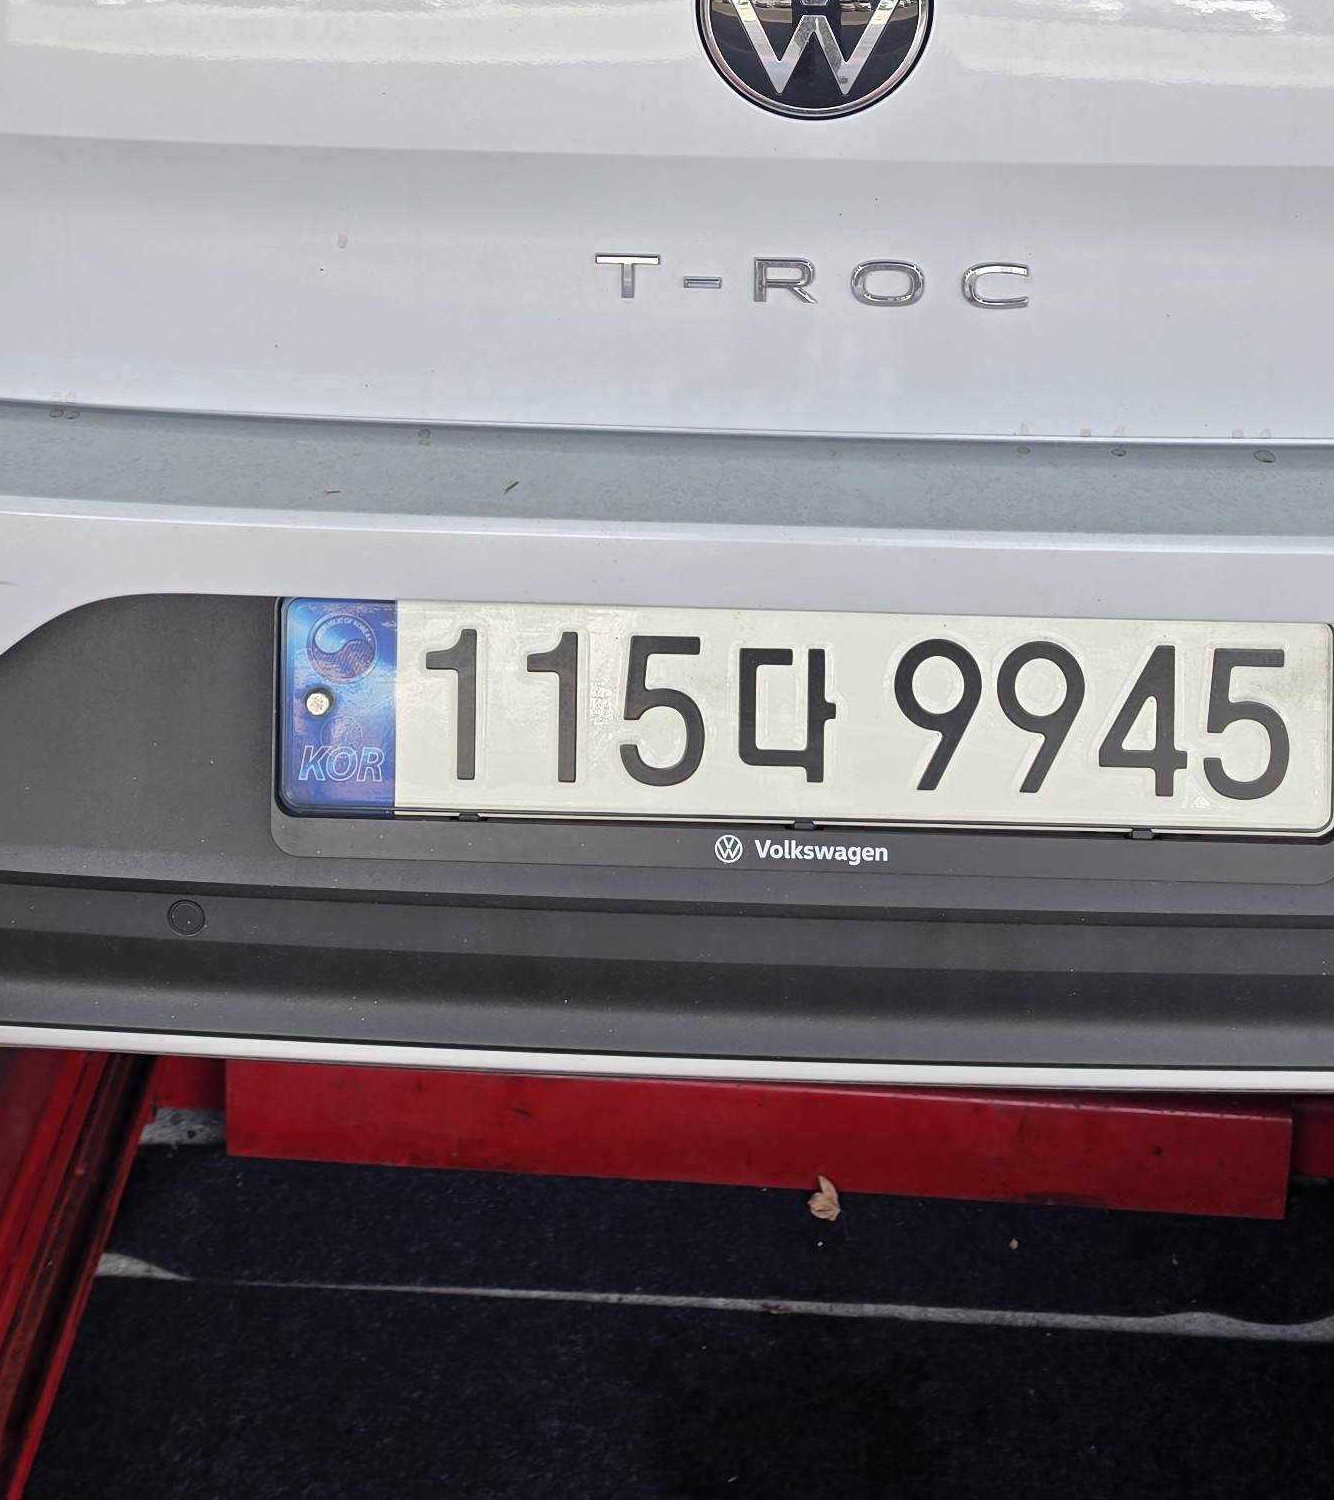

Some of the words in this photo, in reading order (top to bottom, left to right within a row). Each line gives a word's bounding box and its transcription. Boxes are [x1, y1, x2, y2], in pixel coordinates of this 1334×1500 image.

[594, 251, 1033, 310] T-ROC
[893, 637, 1291, 802] 9945
[298, 744, 386, 783] KOR
[754, 839, 889, 866] Volkswagen
